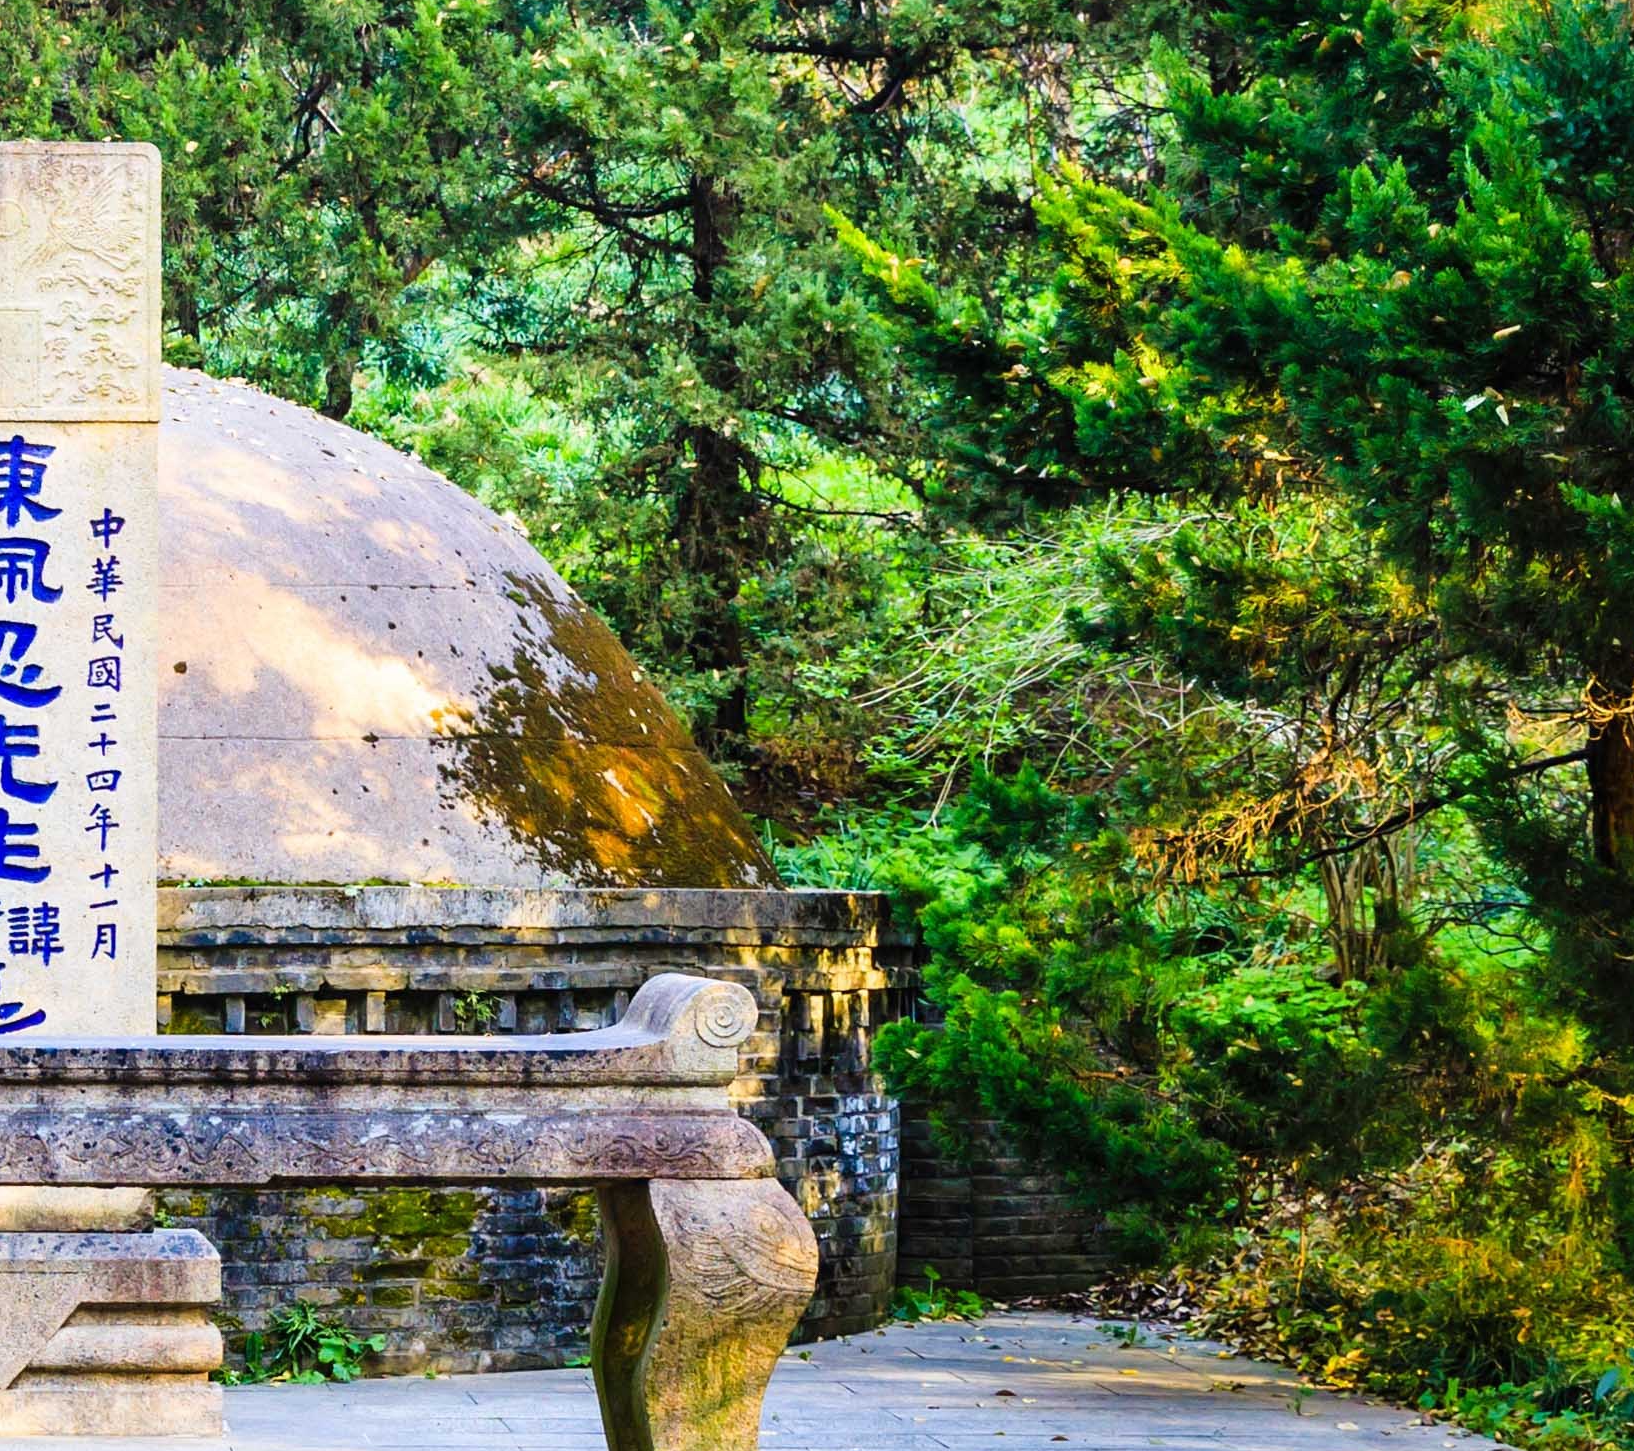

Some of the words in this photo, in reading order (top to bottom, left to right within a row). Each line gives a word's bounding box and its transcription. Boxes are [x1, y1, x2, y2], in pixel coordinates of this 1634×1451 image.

[84, 505, 126, 961] 中華民國二十四年十一月
